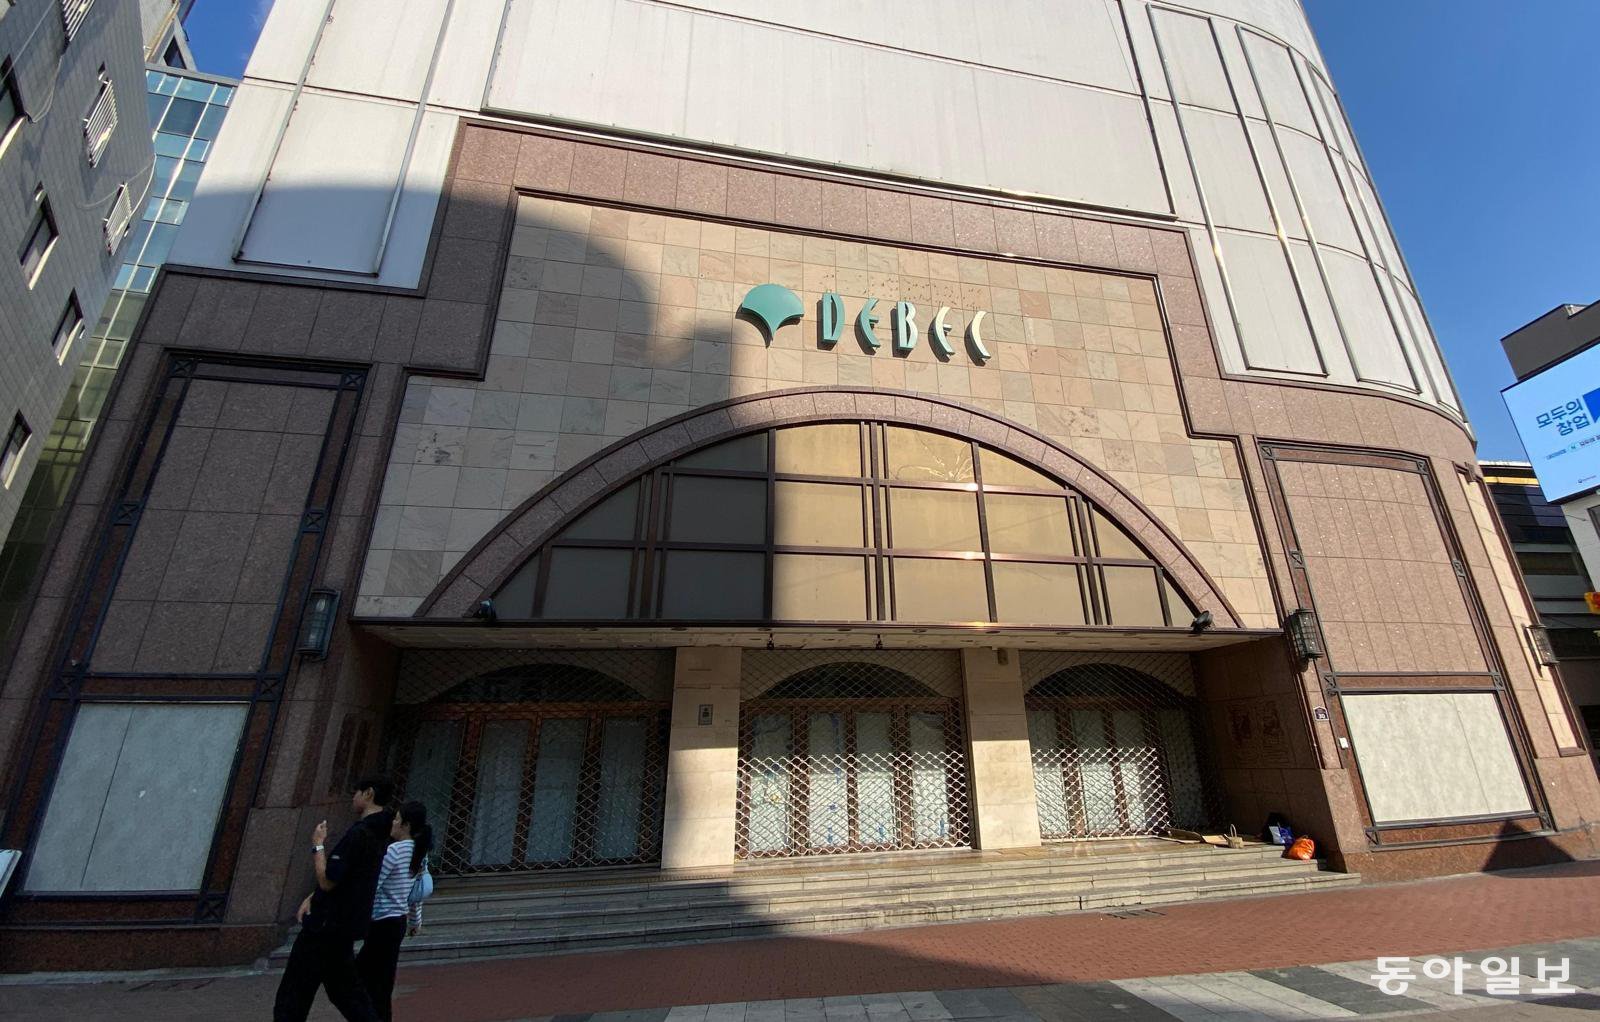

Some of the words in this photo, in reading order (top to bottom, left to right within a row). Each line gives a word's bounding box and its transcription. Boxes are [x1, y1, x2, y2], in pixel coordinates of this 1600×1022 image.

[820, 291, 992, 362] DEBEC
[1536, 398, 1584, 429] 모두의
[1556, 413, 1590, 437] 창업
